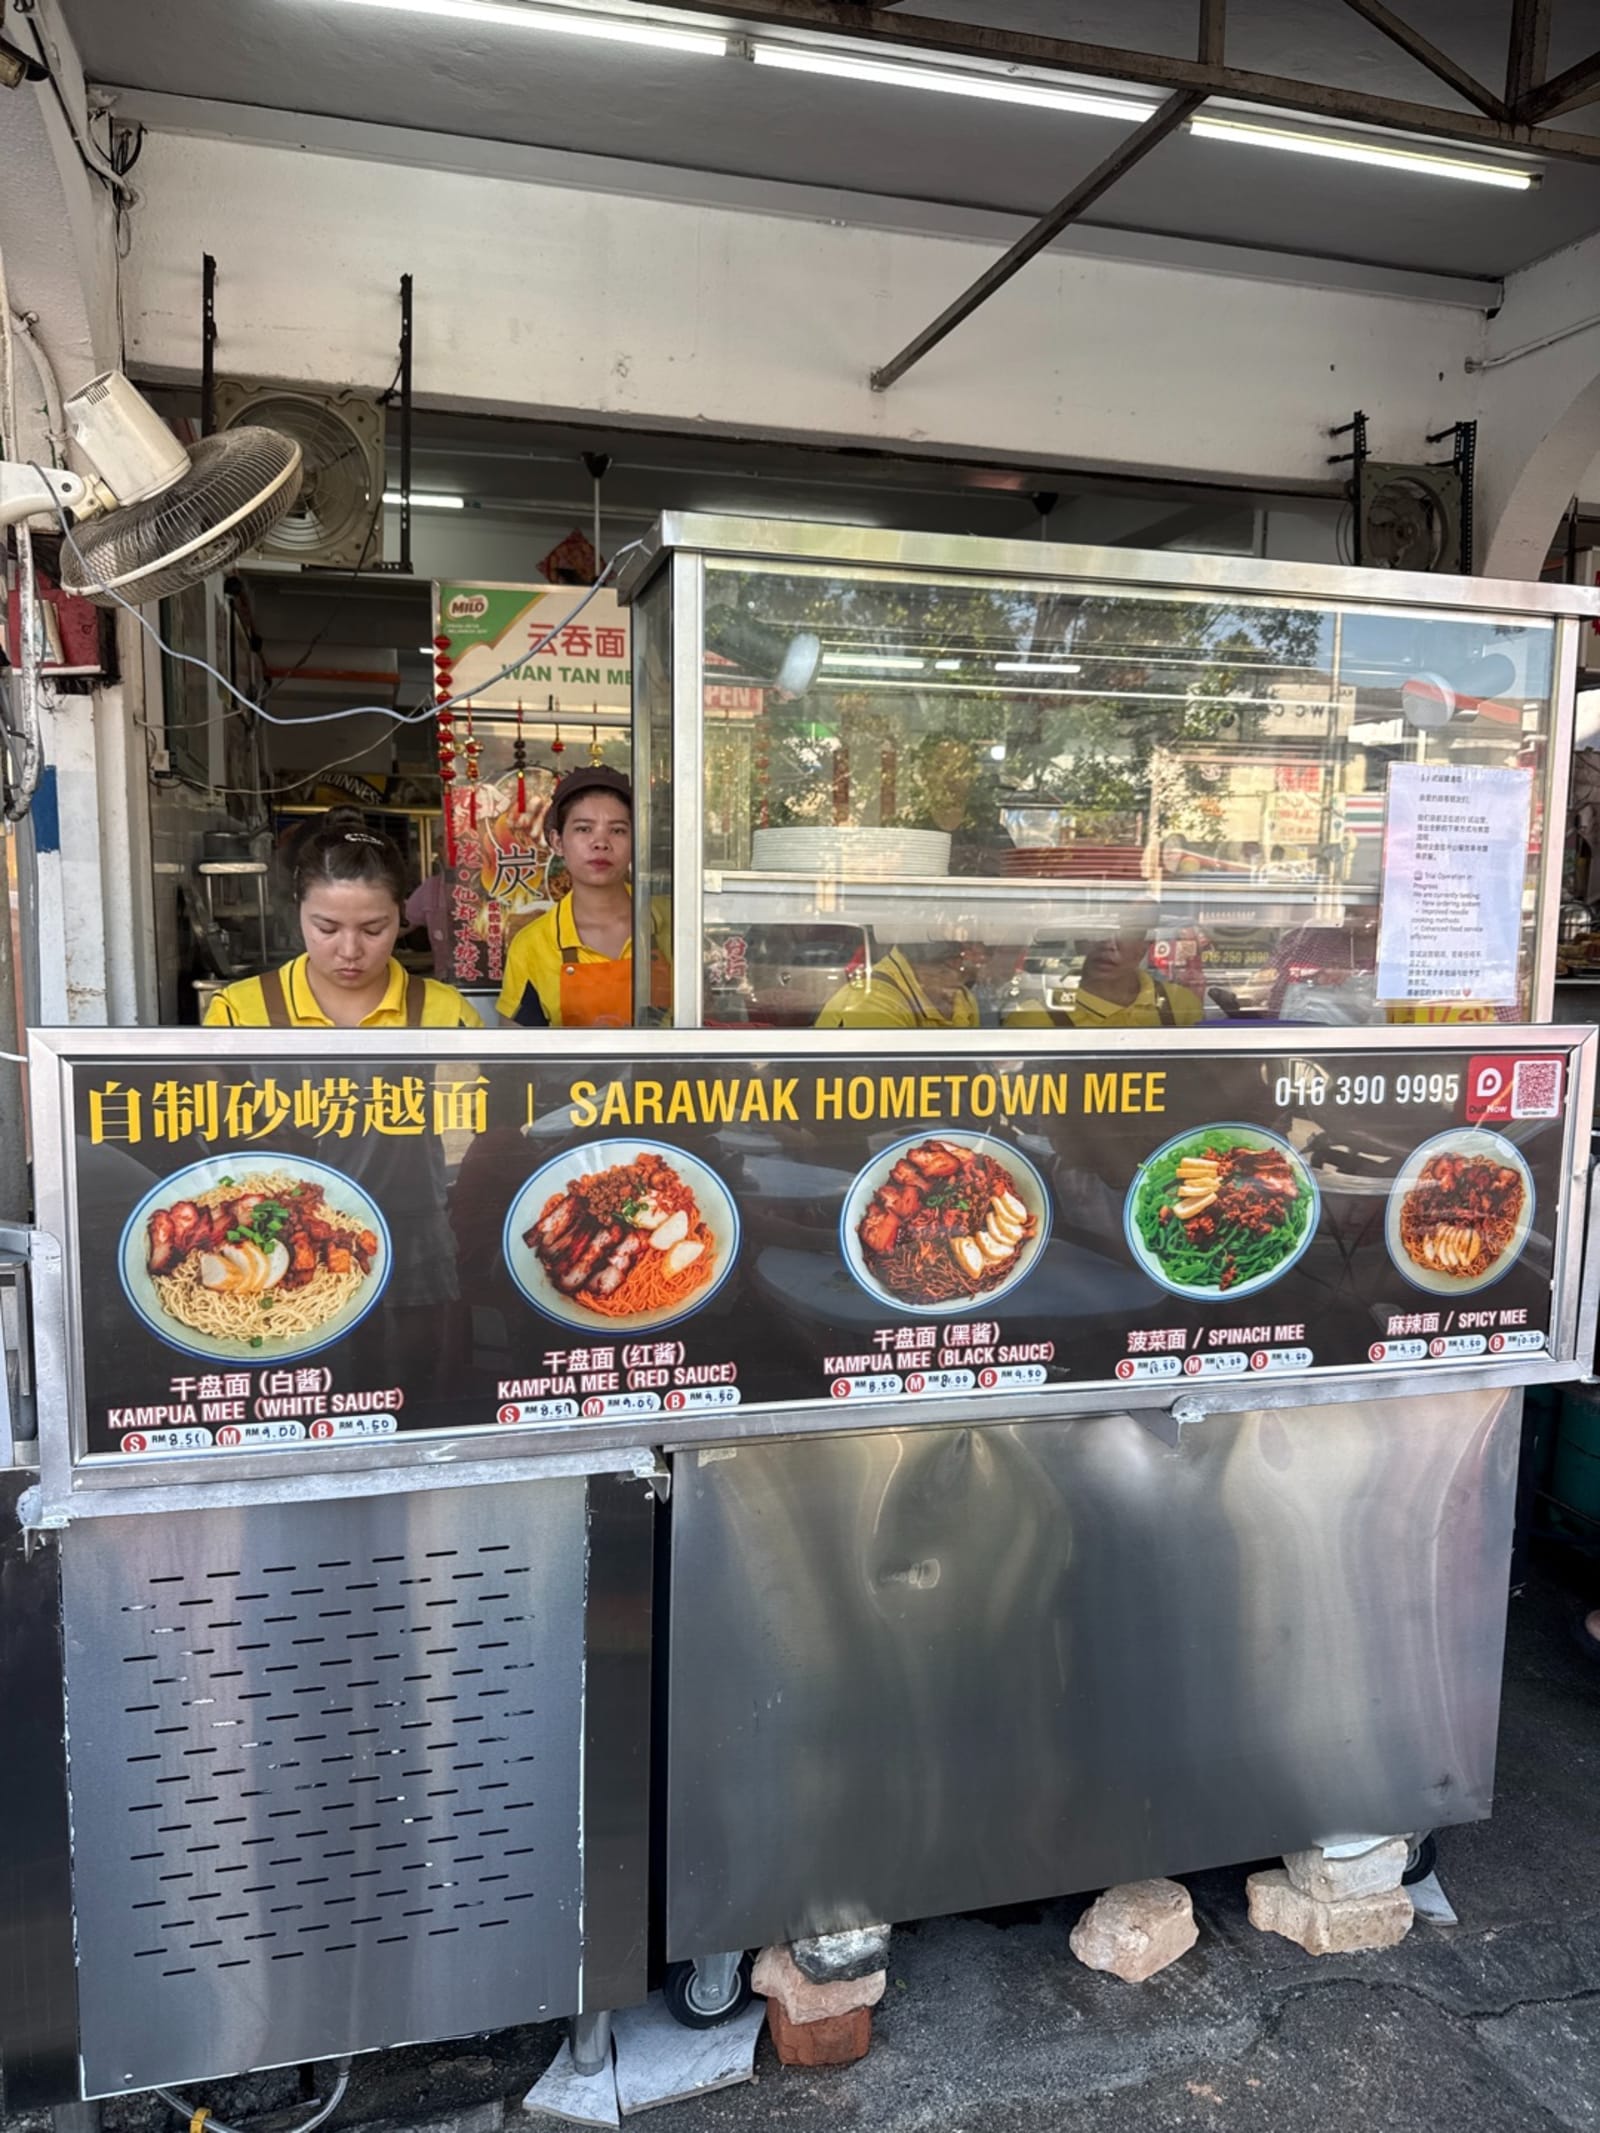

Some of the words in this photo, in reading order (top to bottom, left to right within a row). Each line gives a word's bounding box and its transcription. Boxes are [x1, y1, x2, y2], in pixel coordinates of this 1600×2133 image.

[451, 601, 485, 614] MILO
[527, 623, 626, 658] 云吞面
[502, 664, 552, 682] WAN
[558, 667, 599, 684] TAN
[489, 844, 544, 899] 炭
[569, 1078, 799, 1127] SARAWAK
[815, 1073, 1068, 1121] HOMETOWN
[1083, 1072, 1167, 1114] MEE
[1275, 1075, 1326, 1107] 016
[1336, 1075, 1386, 1105] 390
[1395, 1073, 1460, 1104] 9995
[89, 1075, 491, 1145] 自制砂崂越面
[1127, 1328, 1187, 1353] 菠菜面
[1192, 1327, 1205, 1350] /
[1208, 1326, 1271, 1346] SPINACH
[1274, 1323, 1306, 1341] MEE
[1387, 1313, 1440, 1336] 麻辣面
[1444, 1310, 1455, 1332] /
[1458, 1310, 1497, 1329] SPICY
[1499, 1308, 1528, 1325] MEE
[823, 1353, 894, 1375] KAMPUA
[897, 1351, 931, 1369] MEE
[937, 1346, 995, 1369] (BLACK
[998, 1340, 1056, 1364] SAUCE)
[498, 1376, 577, 1400] KAMPUA
[581, 1373, 620, 1393] MEE
[627, 1368, 670, 1391] (RED
[673, 1362, 738, 1386] SAUCE)
[854, 1380, 866, 1389] RM
[928, 1375, 939, 1383] RM
[1001, 1369, 1013, 1378] RM
[108, 1404, 198, 1429] KAMPUA
[203, 1401, 246, 1421] MEE
[254, 1396, 328, 1421] (WHITE
[332, 1388, 405, 1412] SAUCE)
[525, 1405, 537, 1415] RM
[608, 1398, 620, 1407] RM
[690, 1392, 702, 1401] RM
[152, 1434, 166, 1444] RM
[245, 1428, 260, 1437] RM
[339, 1420, 353, 1430] RM
